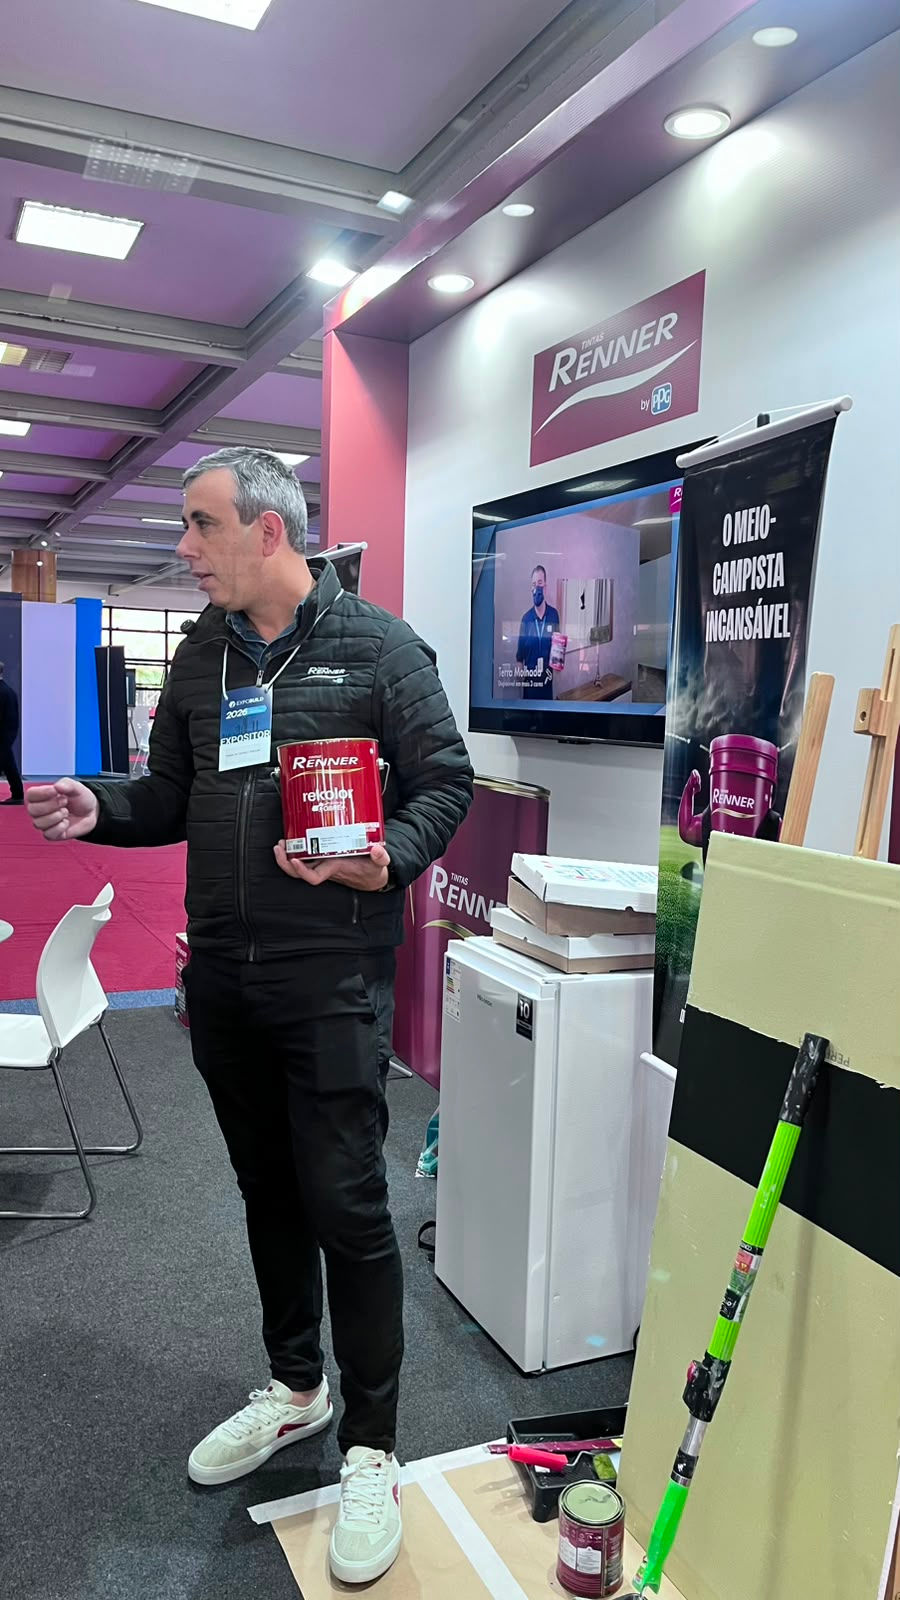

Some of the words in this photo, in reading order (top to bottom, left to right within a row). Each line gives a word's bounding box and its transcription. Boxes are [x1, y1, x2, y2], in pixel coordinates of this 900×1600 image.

[582, 332, 605, 350] TINTAS
[548, 312, 678, 392] RENNER
[640, 399, 650, 411] by
[653, 388, 670, 410] PPG
[722, 513, 733, 547] O
[733, 504, 777, 545] MEIO-
[712, 552, 785, 596] CAMPISTA
[705, 597, 791, 643] INCANSÁVEL
[225, 706, 248, 720] 2026
[220, 729, 271, 745] EXPOSITOR
[292, 756, 359, 770] RENNER
[302, 787, 354, 803] rekolor
[712, 788, 755, 809] RENNER
[451, 872, 469, 886] TINTAS
[429, 864, 508, 923] RENN
